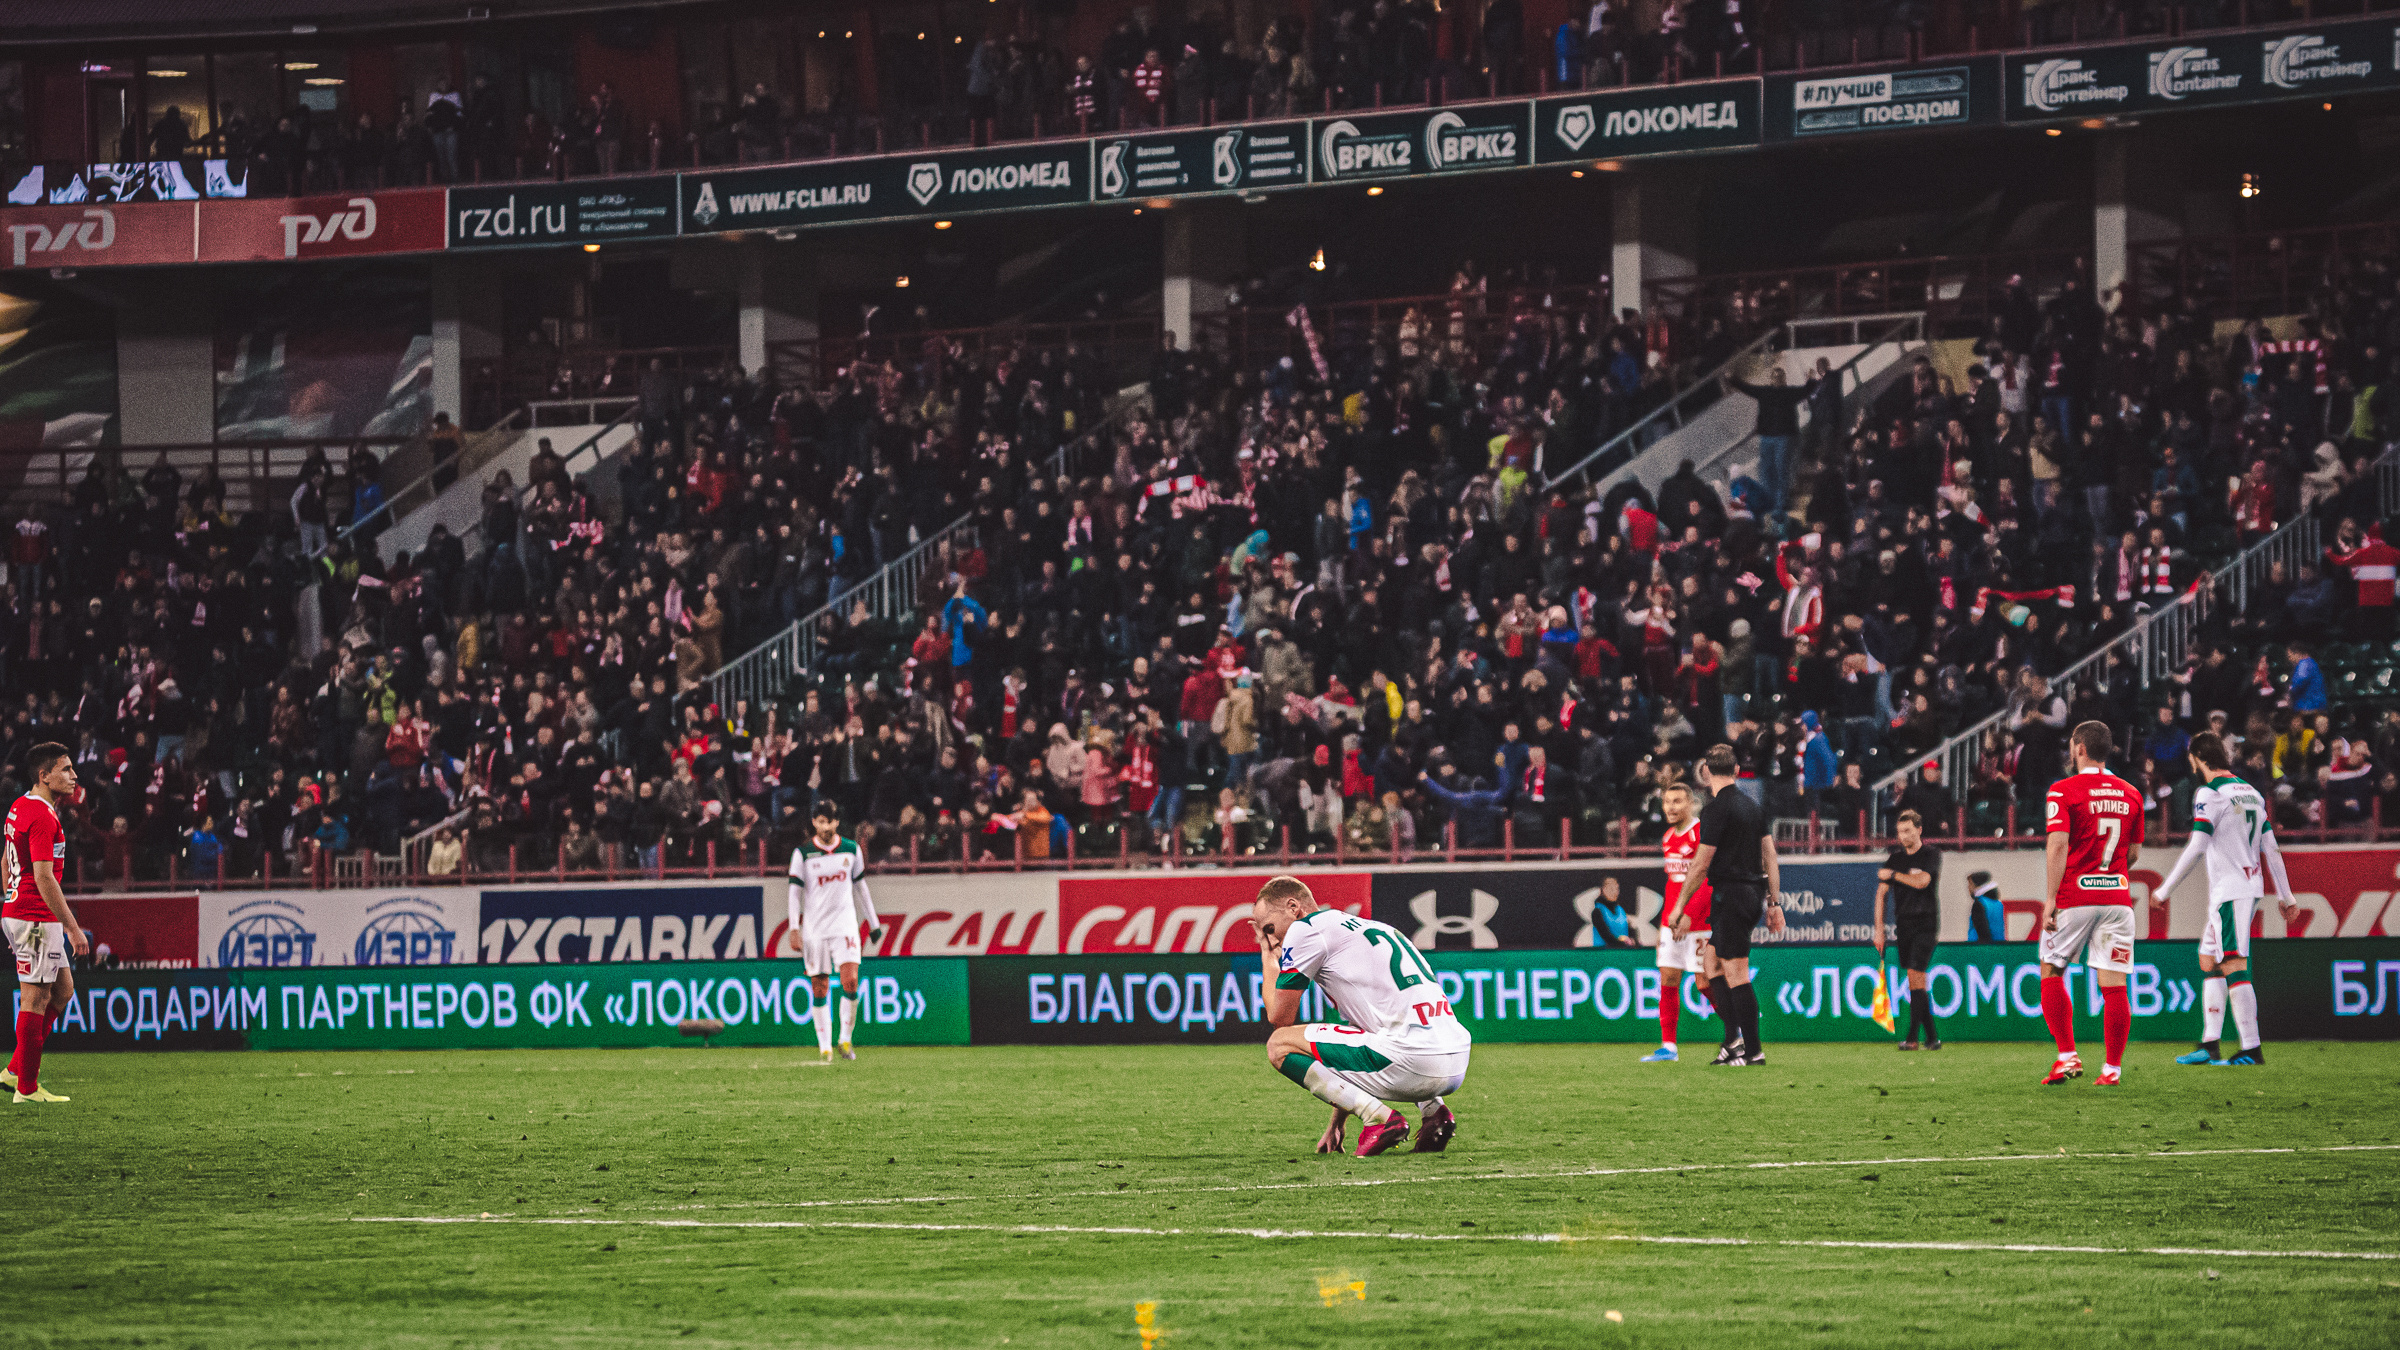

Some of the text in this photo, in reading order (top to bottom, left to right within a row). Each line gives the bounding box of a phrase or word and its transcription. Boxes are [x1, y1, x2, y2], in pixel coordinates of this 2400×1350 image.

[1803, 80, 1886, 105] #лучше
[1604, 101, 1739, 138] ЛОКОМЕД
[1863, 100, 1961, 125] поездом
[950, 161, 1071, 194] ЛОКОМЕД
[729, 183, 872, 215] WWW.FCLM.RU
[459, 194, 566, 238] rzd.ru
[2089, 789, 2125, 797] NISSAN
[2089, 800, 2130, 815] ГУЛИЕВ
[2098, 818, 2121, 871] 7
[2246, 810, 2257, 847] 7
[2083, 877, 2118, 887] Winline
[281, 980, 519, 1030] ПАРТНЕРОВ
[529, 980, 593, 1028] ФК
